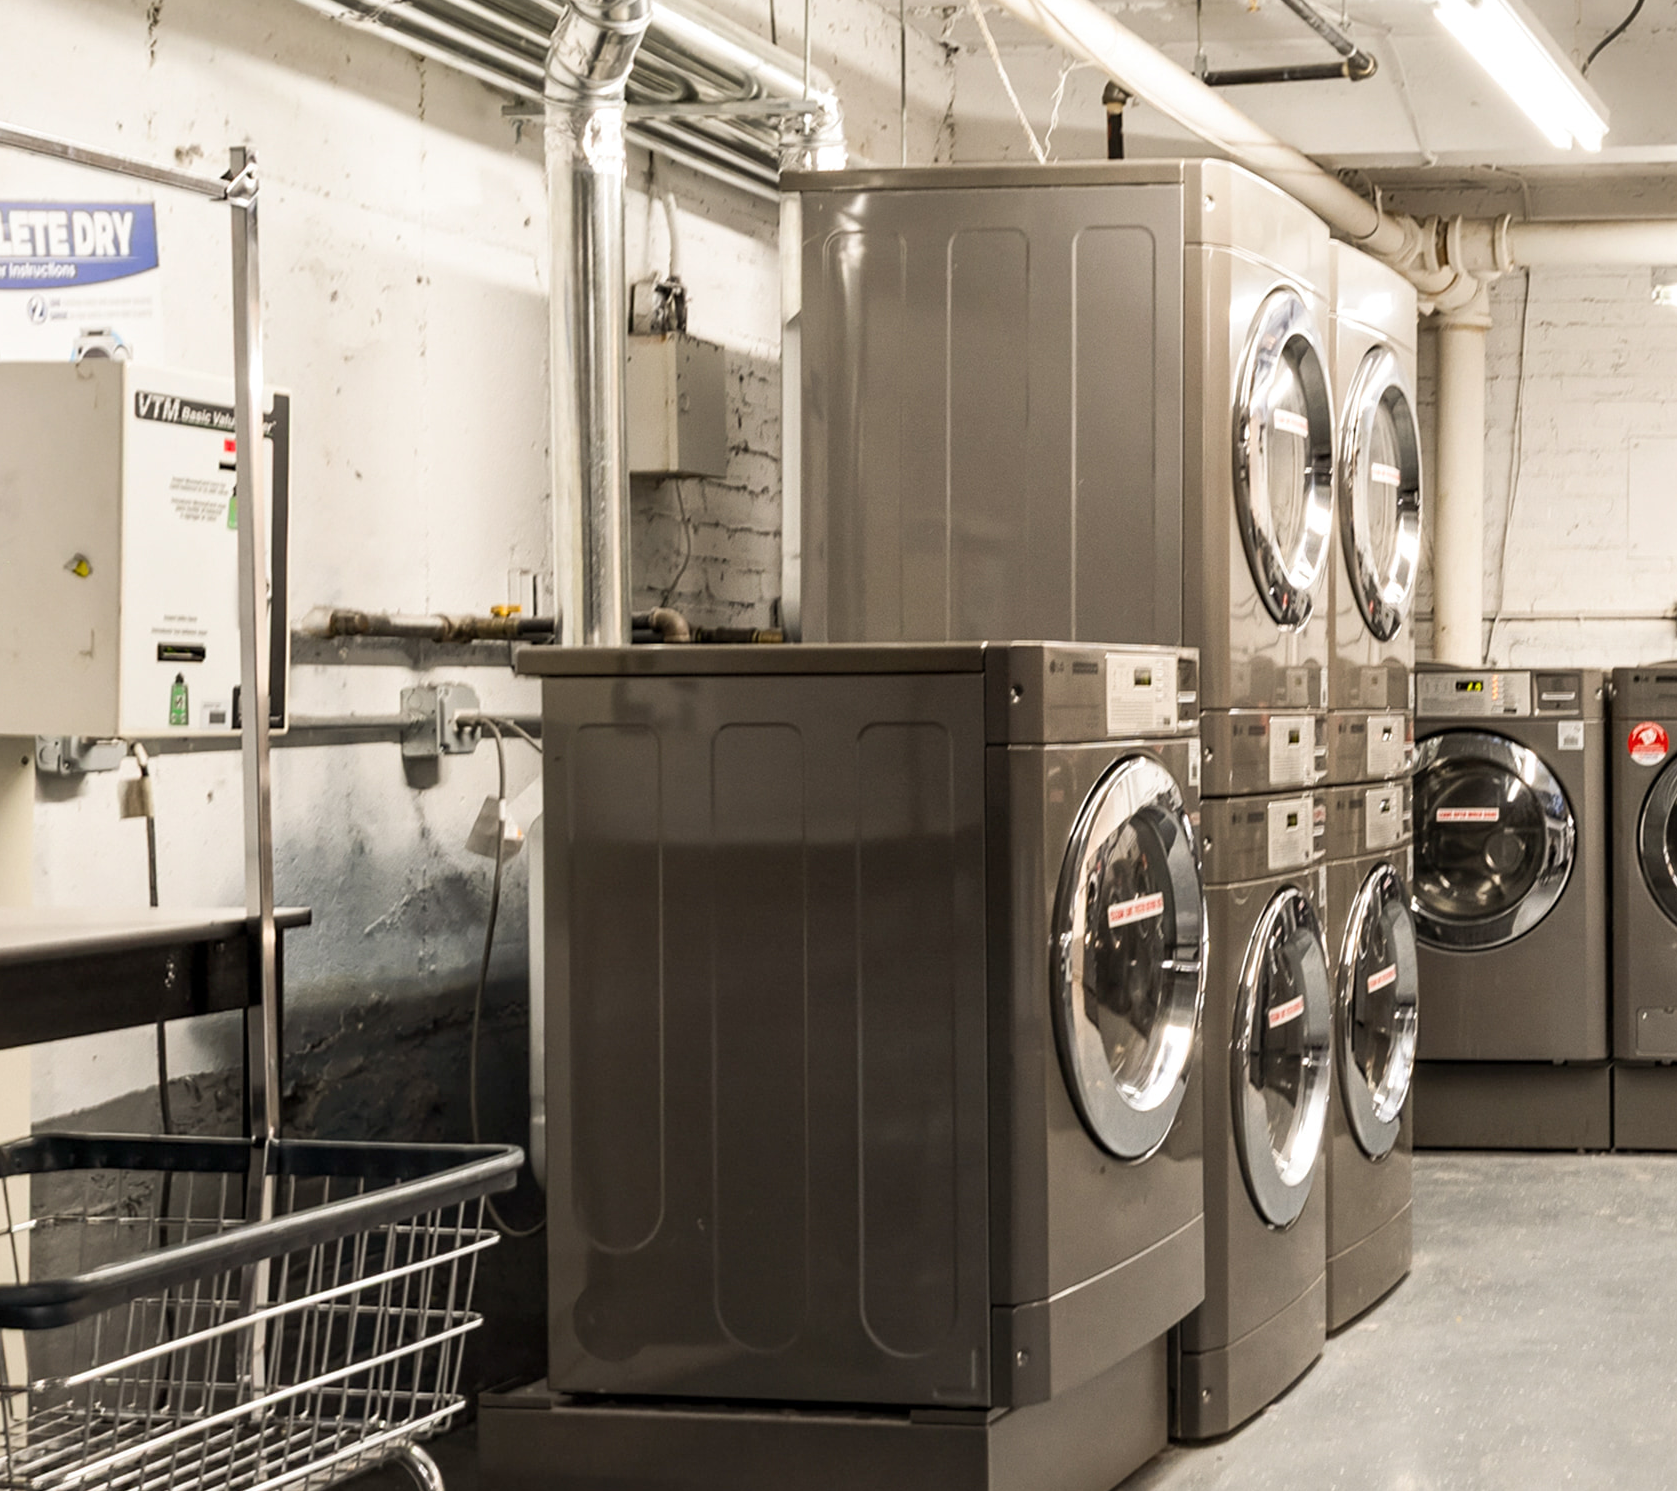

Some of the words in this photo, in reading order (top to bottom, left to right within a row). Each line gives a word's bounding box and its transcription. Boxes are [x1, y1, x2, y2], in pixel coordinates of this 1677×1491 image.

[72, 210, 134, 257] DRY
[8, 261, 77, 280] Instructions
[138, 391, 181, 422] VTM
[181, 406, 211, 427] Basic
[213, 411, 236, 431] Valu
